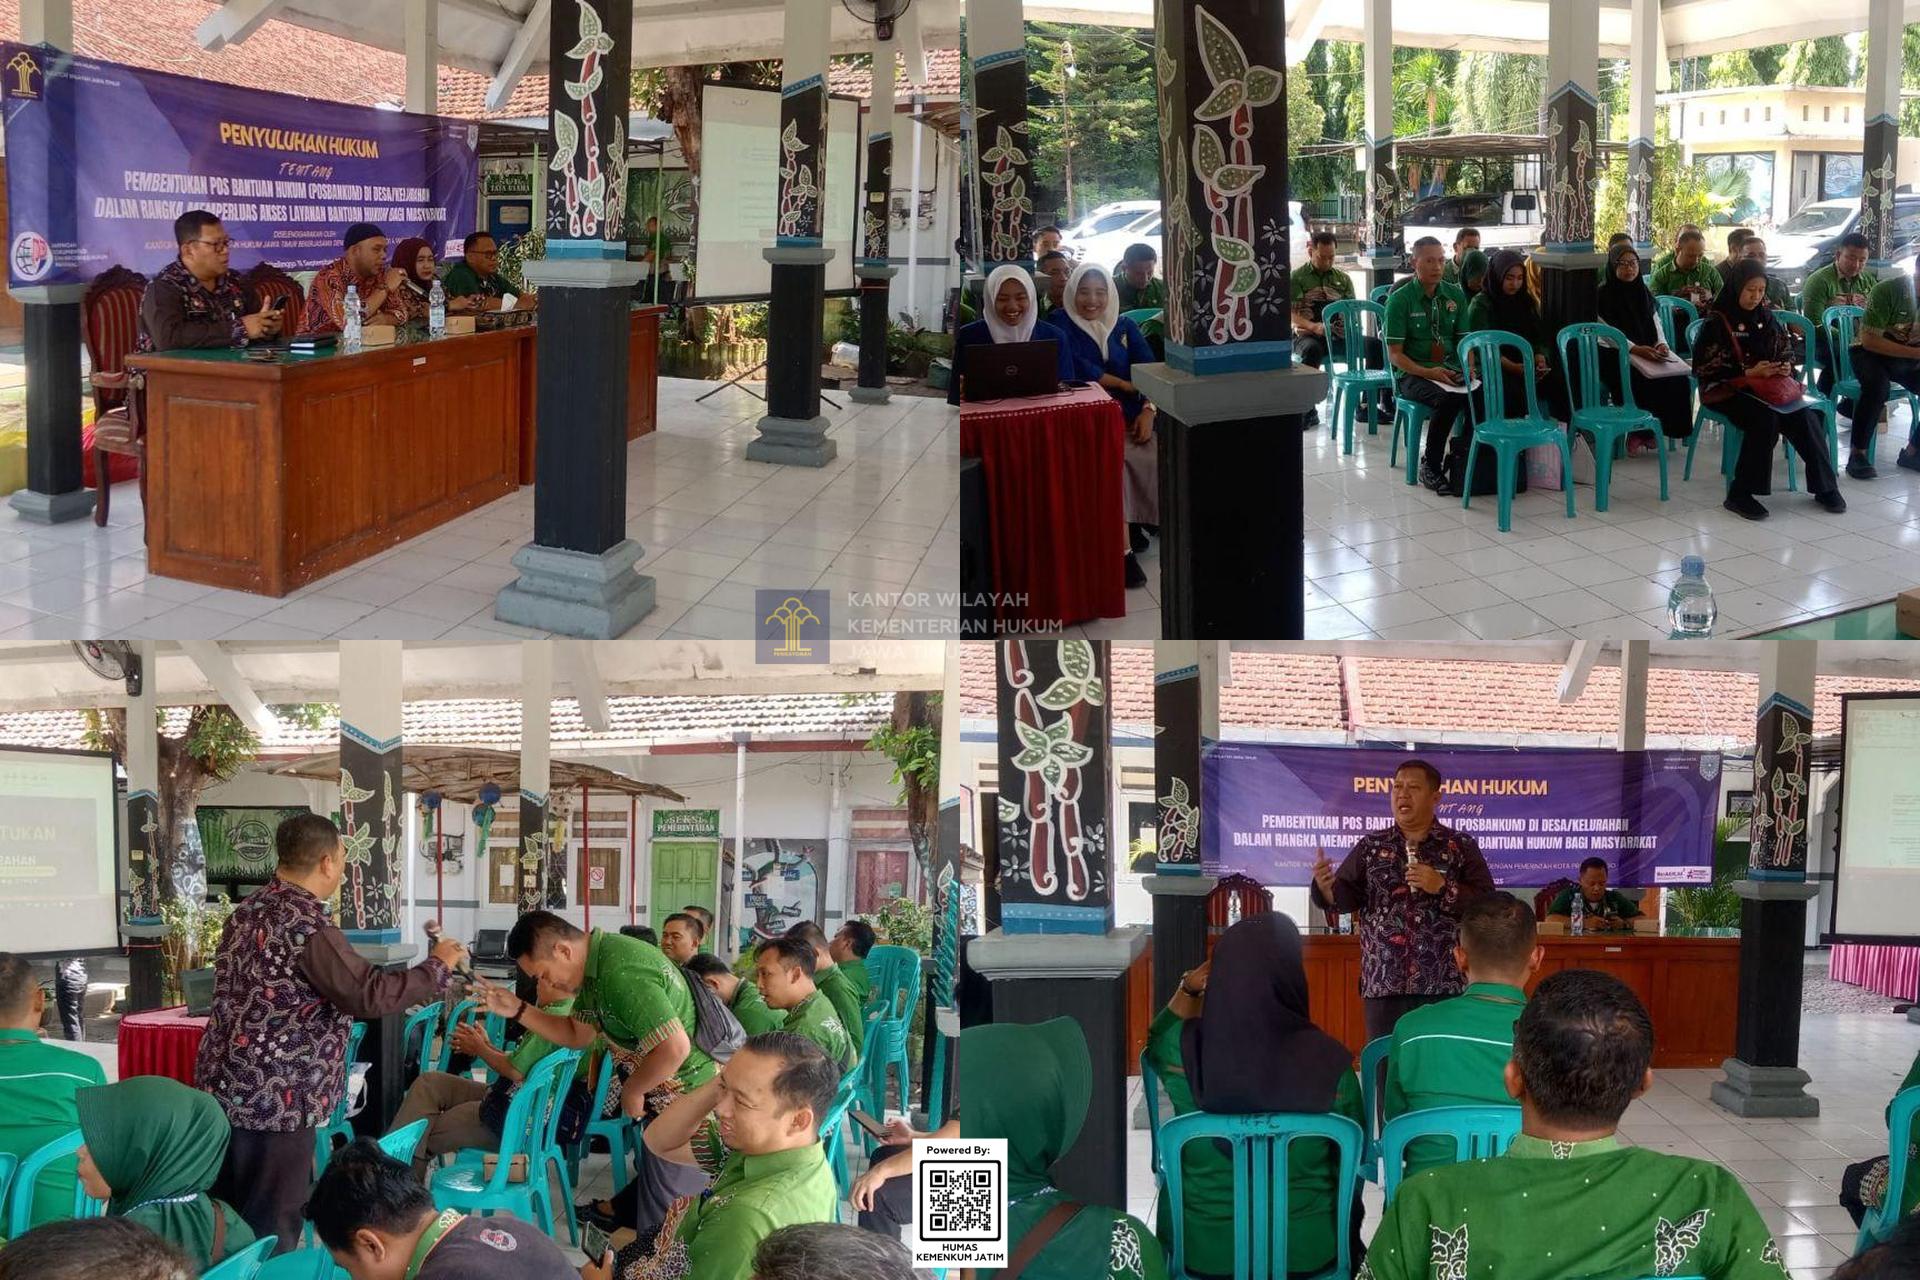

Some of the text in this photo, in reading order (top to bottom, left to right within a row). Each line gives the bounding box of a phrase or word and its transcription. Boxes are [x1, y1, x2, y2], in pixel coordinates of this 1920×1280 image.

[220, 122, 380, 159] PENYULUHAN HUKUM
[124, 170, 208, 195] PEMBENTUKAN
[209, 176, 230, 196] POS
[232, 178, 274, 198] BANTUAN
[275, 180, 307, 199] HUKUM
[363, 186, 372, 202] DI
[94, 197, 140, 219] DALAM
[141, 199, 184, 220] RANGKA
[259, 202, 288, 222] AKSES
[288, 205, 327, 222] LAYANAN
[327, 206, 363, 222] BANTUAN
[1481, 779, 1548, 796] HUKUM
[1262, 814, 1340, 830] PEMBENTUKAN
[1342, 815, 1363, 830] POS
[1455, 818, 1526, 832] (POSBANKUM)
[1528, 818, 1539, 832] DI
[1541, 818, 1629, 832] DESA/KELURAHAN
[1233, 832, 1272, 847] DALAM
[1274, 833, 1317, 848] RANGKA
[1478, 836, 1524, 850] BANTUAN
[1527, 836, 1563, 850] HUKUM
[1565, 836, 1588, 850] BAGI
[1590, 835, 1658, 850] MASYARAKAT
